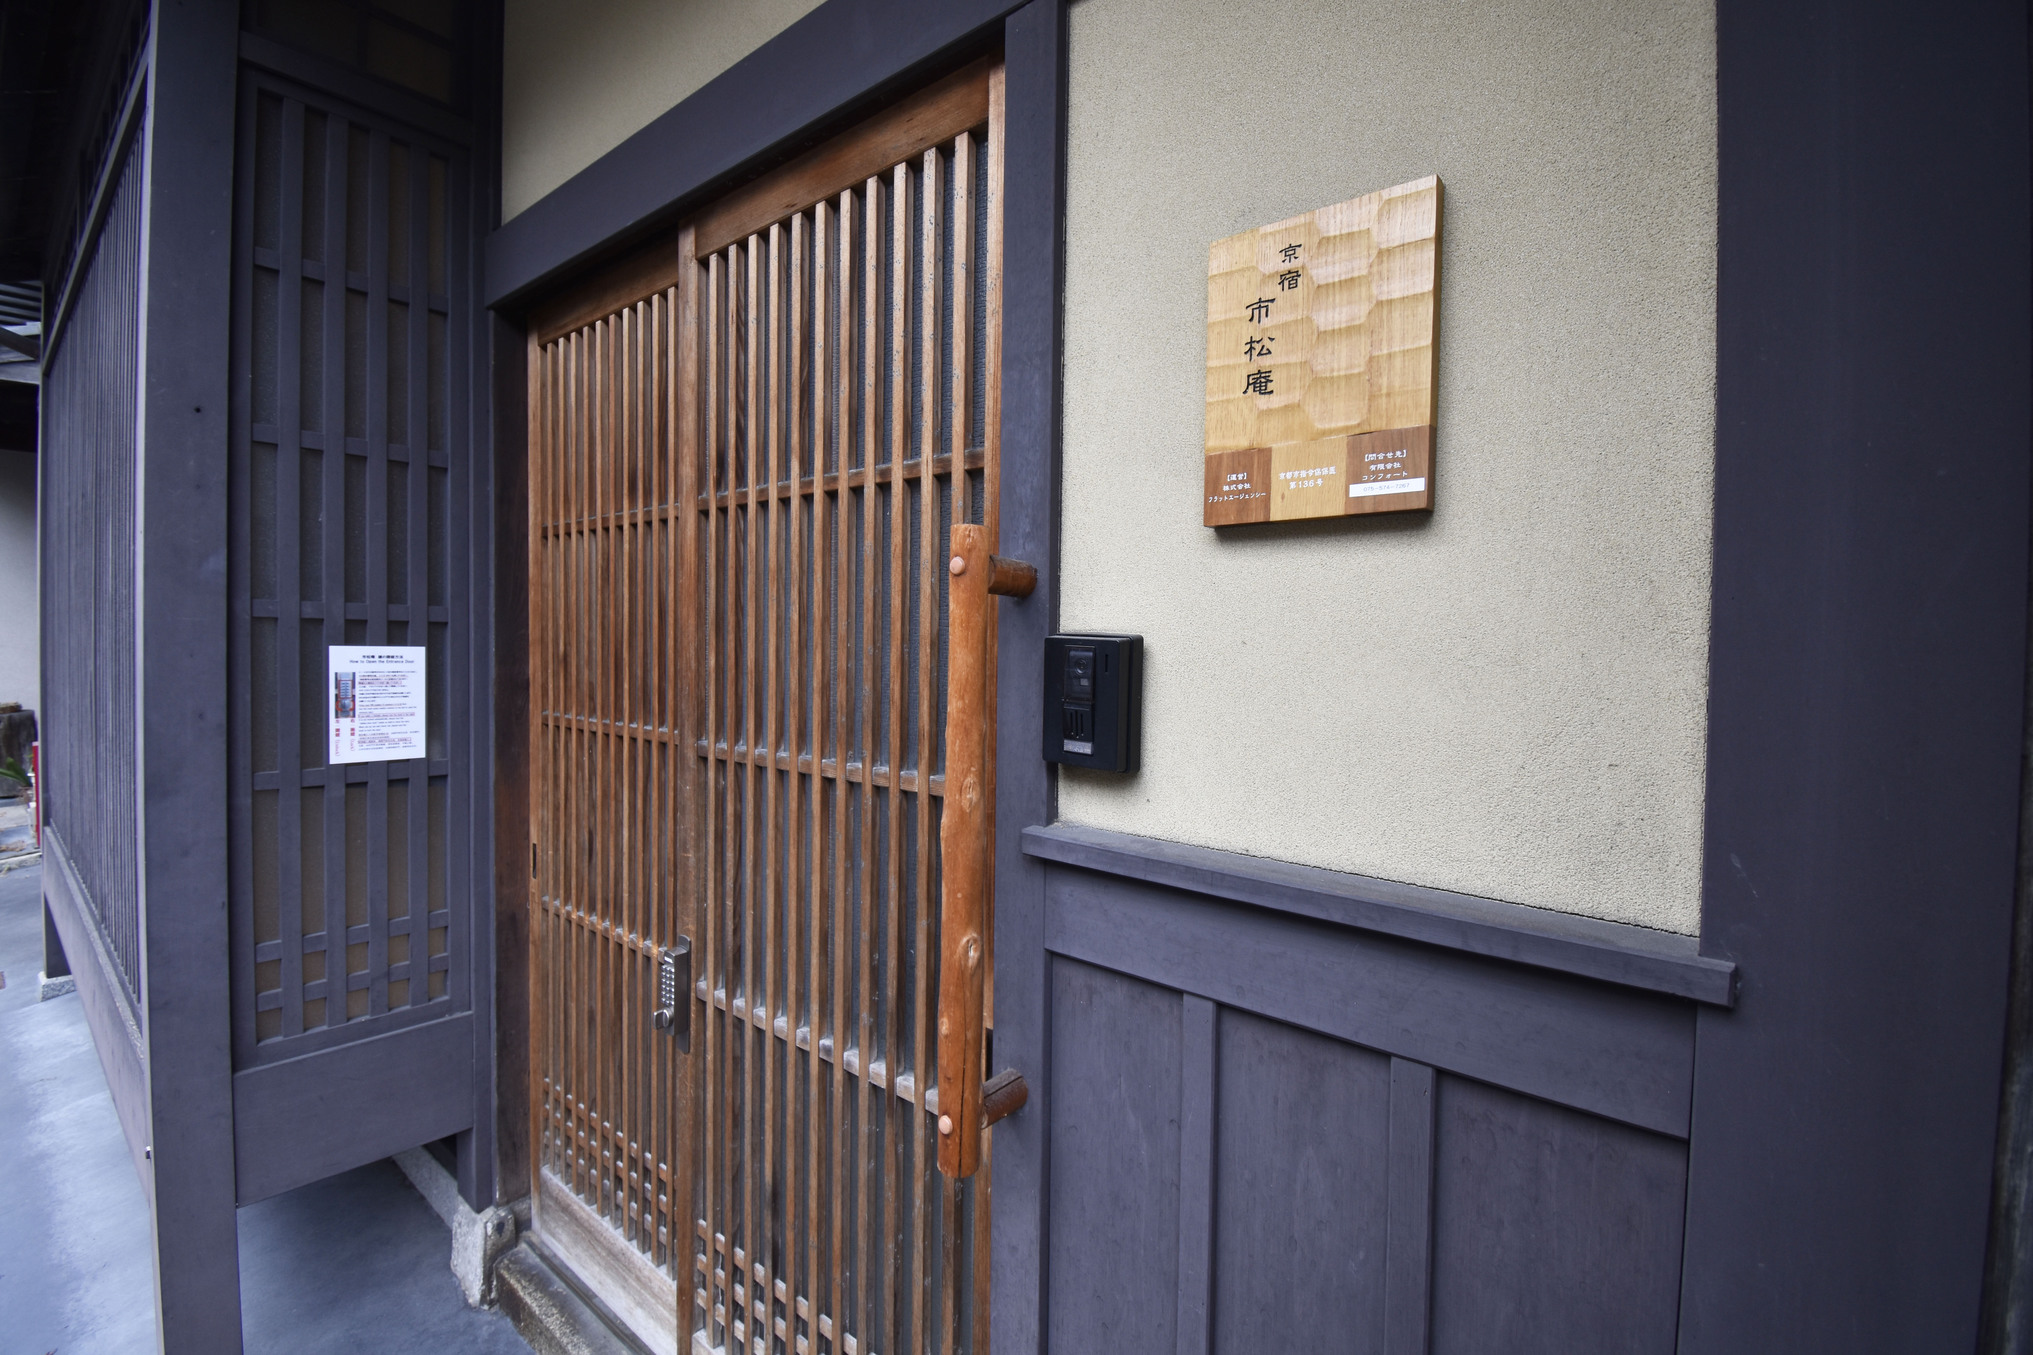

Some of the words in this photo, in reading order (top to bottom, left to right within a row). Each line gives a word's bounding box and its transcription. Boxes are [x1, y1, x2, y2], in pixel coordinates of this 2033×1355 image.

[1278, 243, 1302, 292] 京宿
[1242, 297, 1276, 395] 市松庵
[1369, 461, 1402, 471] 有限会社
[1361, 470, 1408, 481] コンフォート
[1222, 482, 1252, 492] 株式会社
